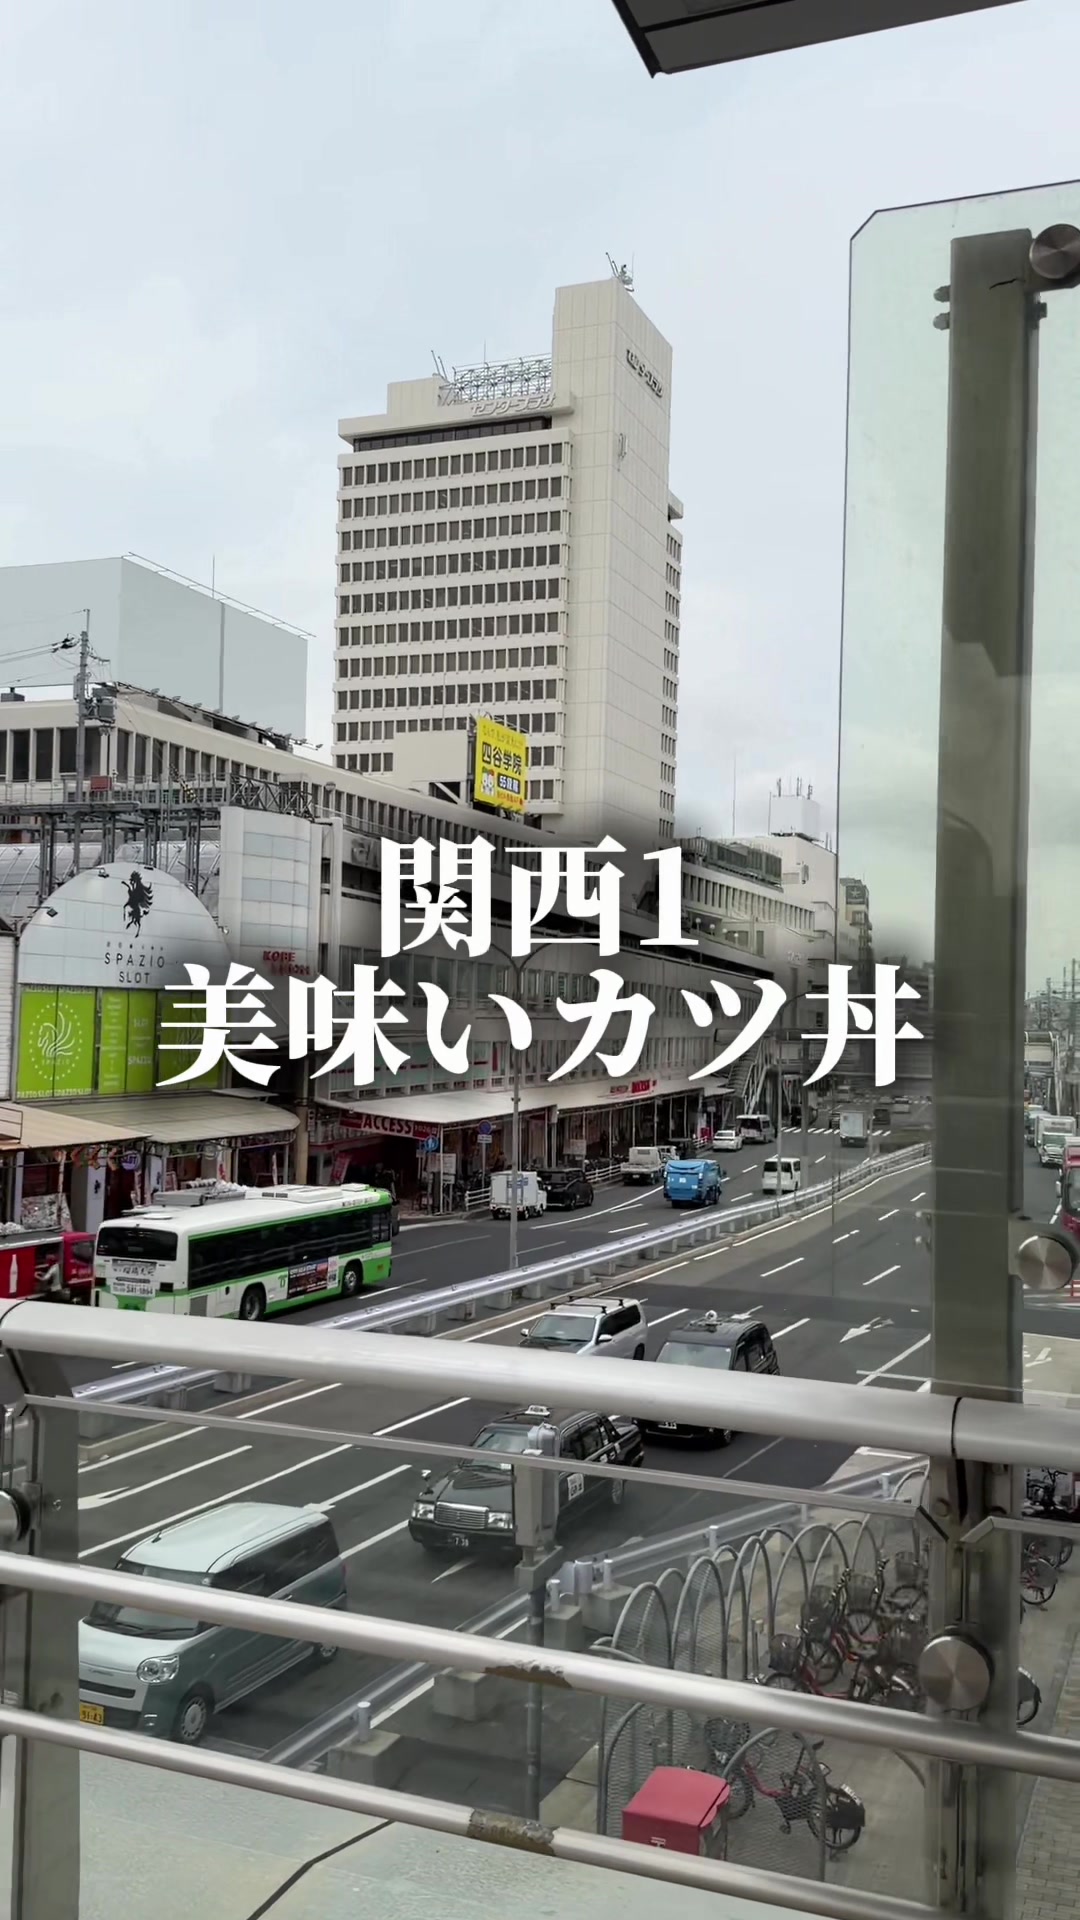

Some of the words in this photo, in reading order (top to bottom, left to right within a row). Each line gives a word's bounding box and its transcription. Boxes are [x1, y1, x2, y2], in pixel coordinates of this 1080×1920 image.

[471, 393, 556, 417] センタープラザ
[482, 741, 522, 776] 四谷学院
[104, 952, 165, 968] SPAZIO
[263, 951, 296, 962] KOBE
[119, 971, 151, 984] SLOT
[363, 1114, 412, 1134] ACCESS
